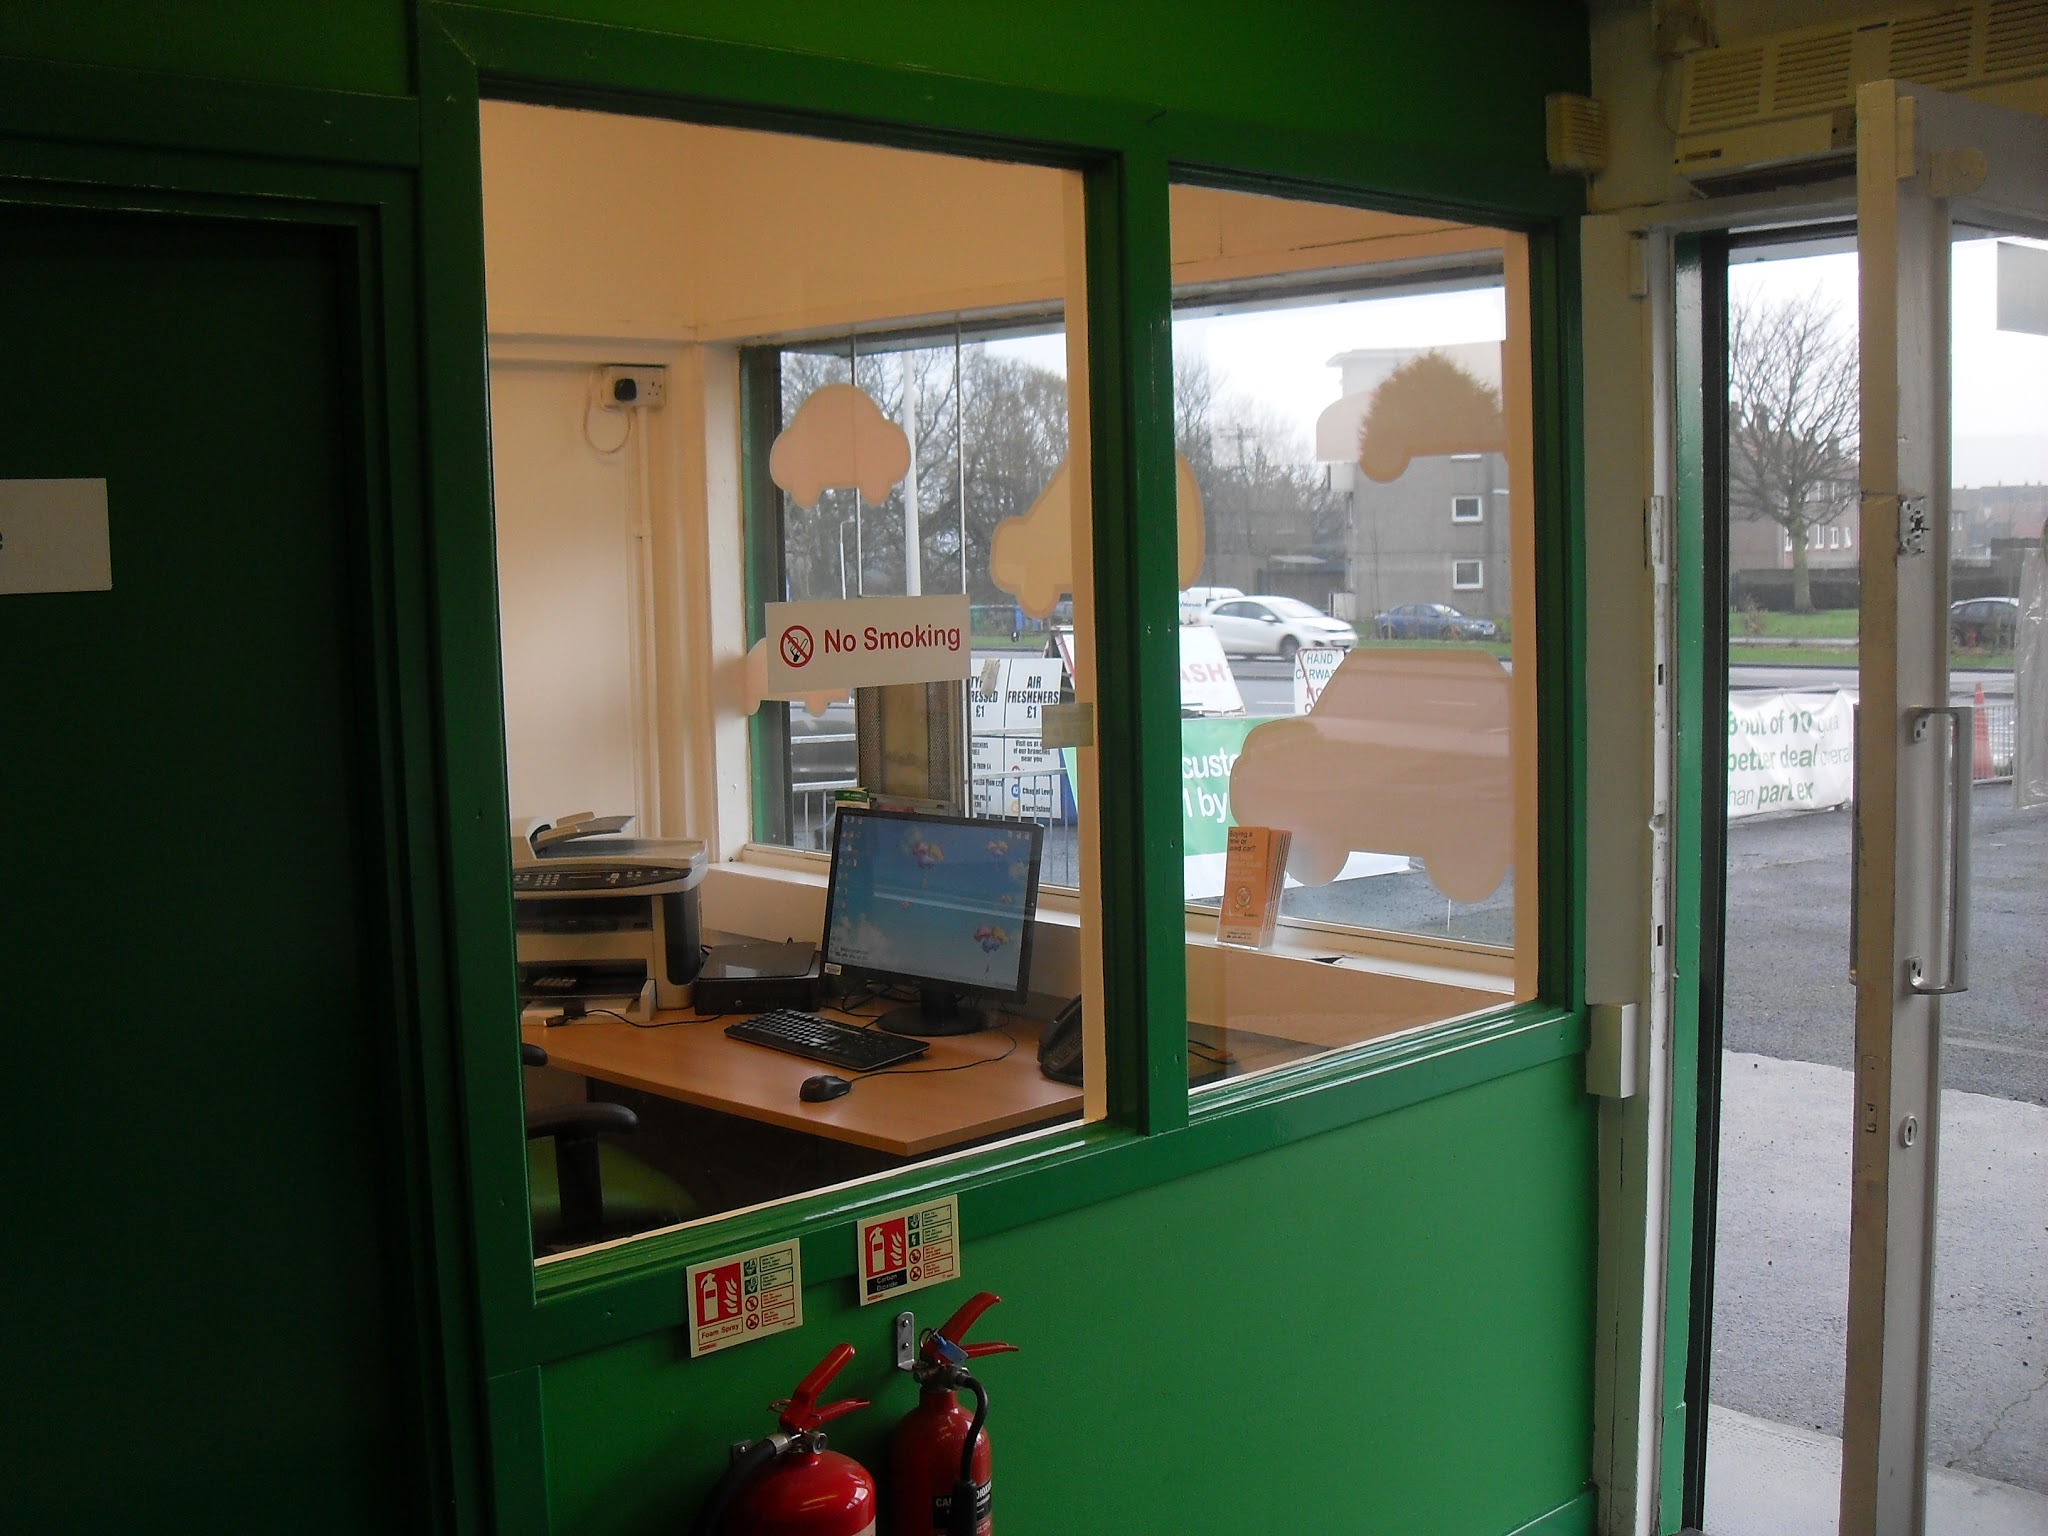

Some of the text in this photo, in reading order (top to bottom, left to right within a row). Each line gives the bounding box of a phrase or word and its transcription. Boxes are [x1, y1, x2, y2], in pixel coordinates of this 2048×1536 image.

[825, 624, 961, 653] No Smoking
[1307, 653, 1333, 664] HAND
[1027, 676, 1042, 689] AIR
[1008, 690, 1059, 704] FRESHENERS
[976, 705, 984, 718] £1
[1027, 705, 1037, 719] £1
[1770, 709, 1784, 734] of
[1789, 710, 1814, 734] 10
[1780, 742, 1818, 767] deal
[1757, 777, 1795, 810] part
[1797, 780, 1815, 801] ex
[1197, 786, 1228, 824] by
[876, 1273, 898, 1284] Carbon
[876, 1281, 898, 1292] Dioxide
[701, 1324, 740, 1339] Foam Spray
